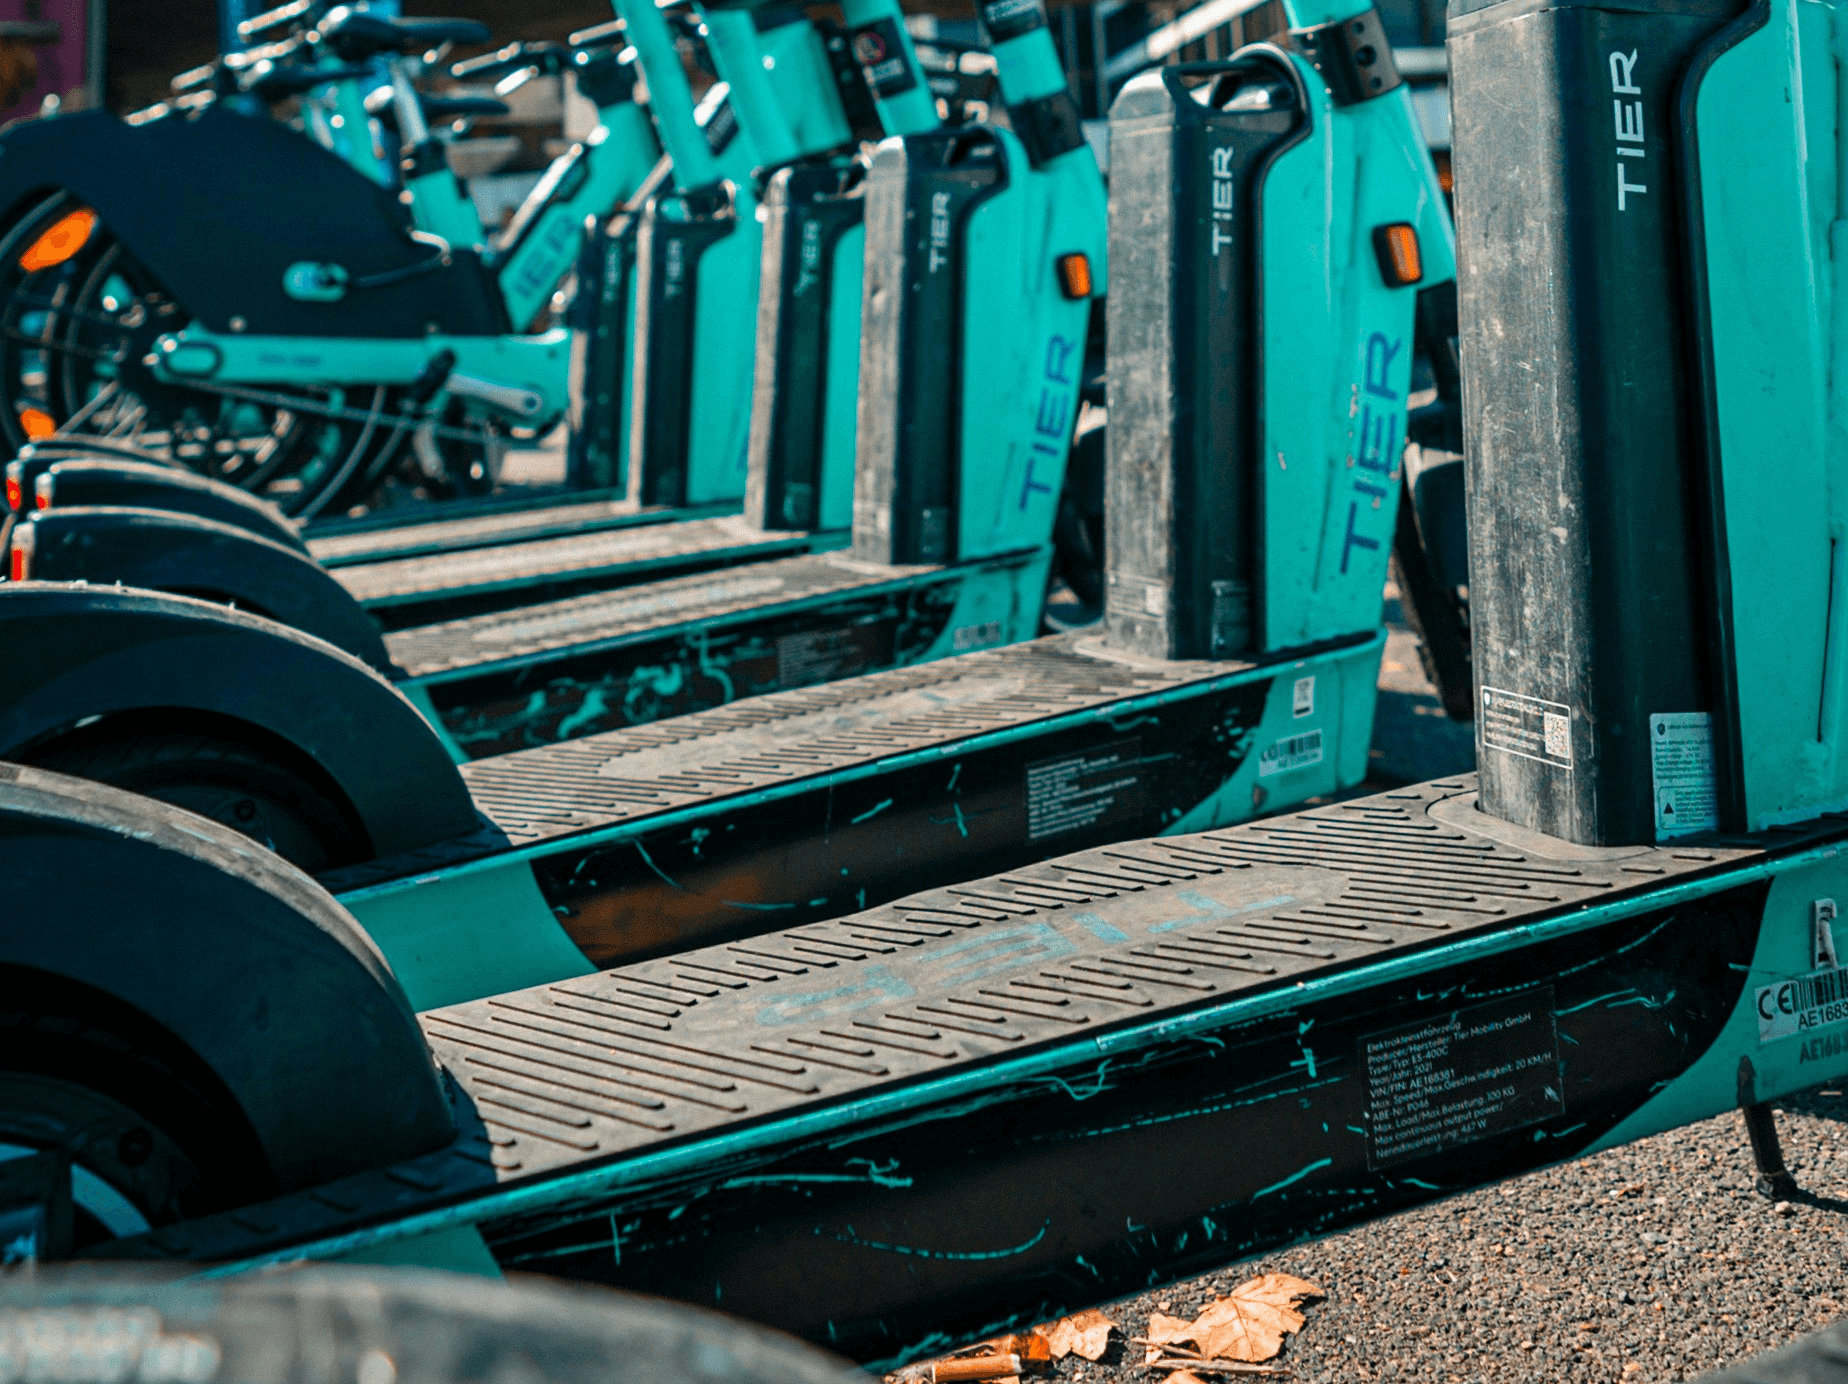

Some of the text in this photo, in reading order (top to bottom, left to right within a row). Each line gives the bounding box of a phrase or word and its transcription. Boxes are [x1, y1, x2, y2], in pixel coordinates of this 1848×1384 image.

[1609, 48, 1647, 212] TIER
[1212, 146, 1234, 256] TIER
[929, 192, 951, 273] TIER
[1019, 333, 1077, 512] TIER
[1340, 330, 1401, 575] TIER
[1454, 1030, 1469, 1040] Tier
[1505, 1013, 1531, 1026] GmbH
[1412, 1047, 1449, 1063] ES-400C
[1516, 1060, 1526, 1068] 20
[1527, 1053, 1551, 1065] KM/H
[1414, 1063, 1432, 1074] 2021
[1409, 1069, 1455, 1089] AE168381
[1487, 1090, 1501, 1100] 100
[1408, 1100, 1429, 1111] P046
[1444, 1112, 1472, 1126] output
[1477, 1120, 1487, 1129] W
